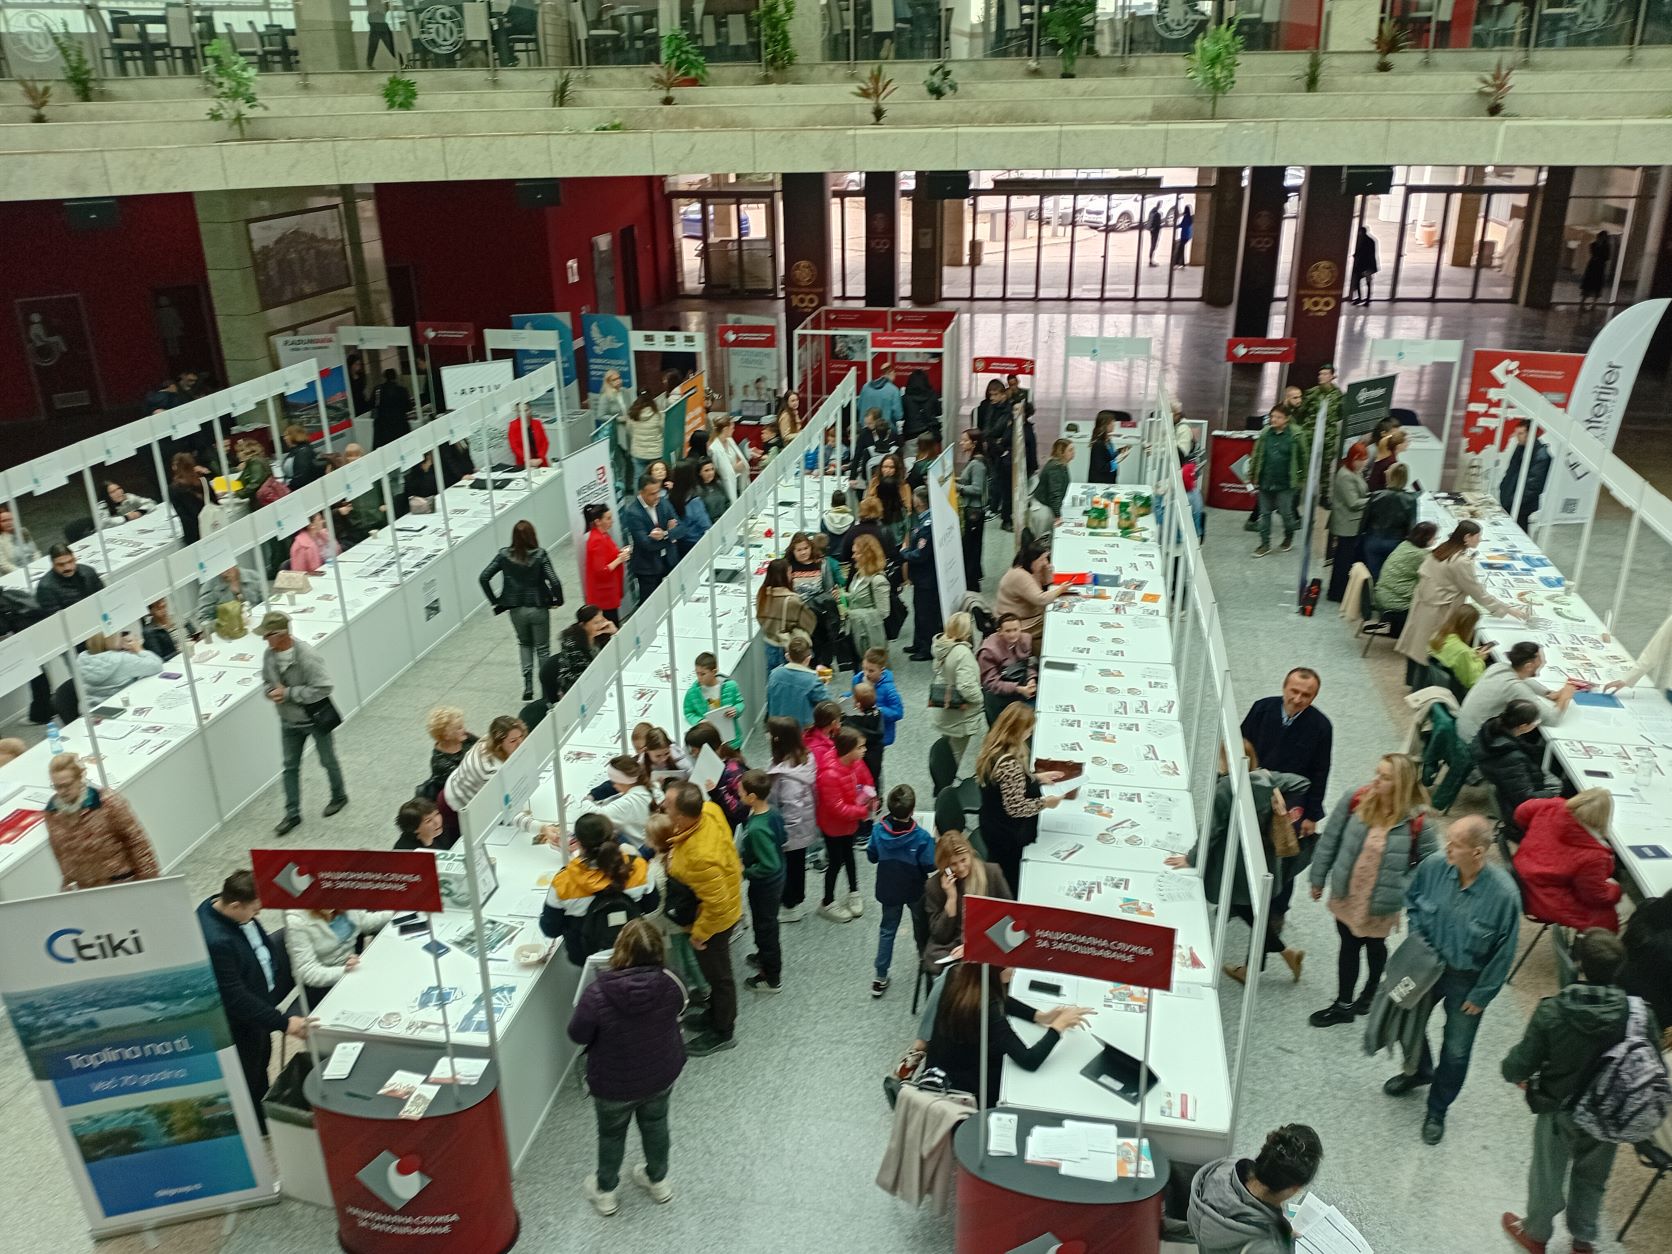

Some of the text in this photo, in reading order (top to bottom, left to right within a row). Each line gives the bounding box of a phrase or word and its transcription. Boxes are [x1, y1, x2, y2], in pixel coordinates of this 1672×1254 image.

[791, 294, 819, 308] 100
[1302, 297, 1336, 311] 100
[1035, 929, 1154, 956] НАЦИОНАЛНА СЛУЖБА
[1036, 940, 1136, 963] ЗА ЗАПОШЉАВАЊЕ
[64, 1046, 142, 1070] Toplina
[143, 1040, 174, 1056] na
